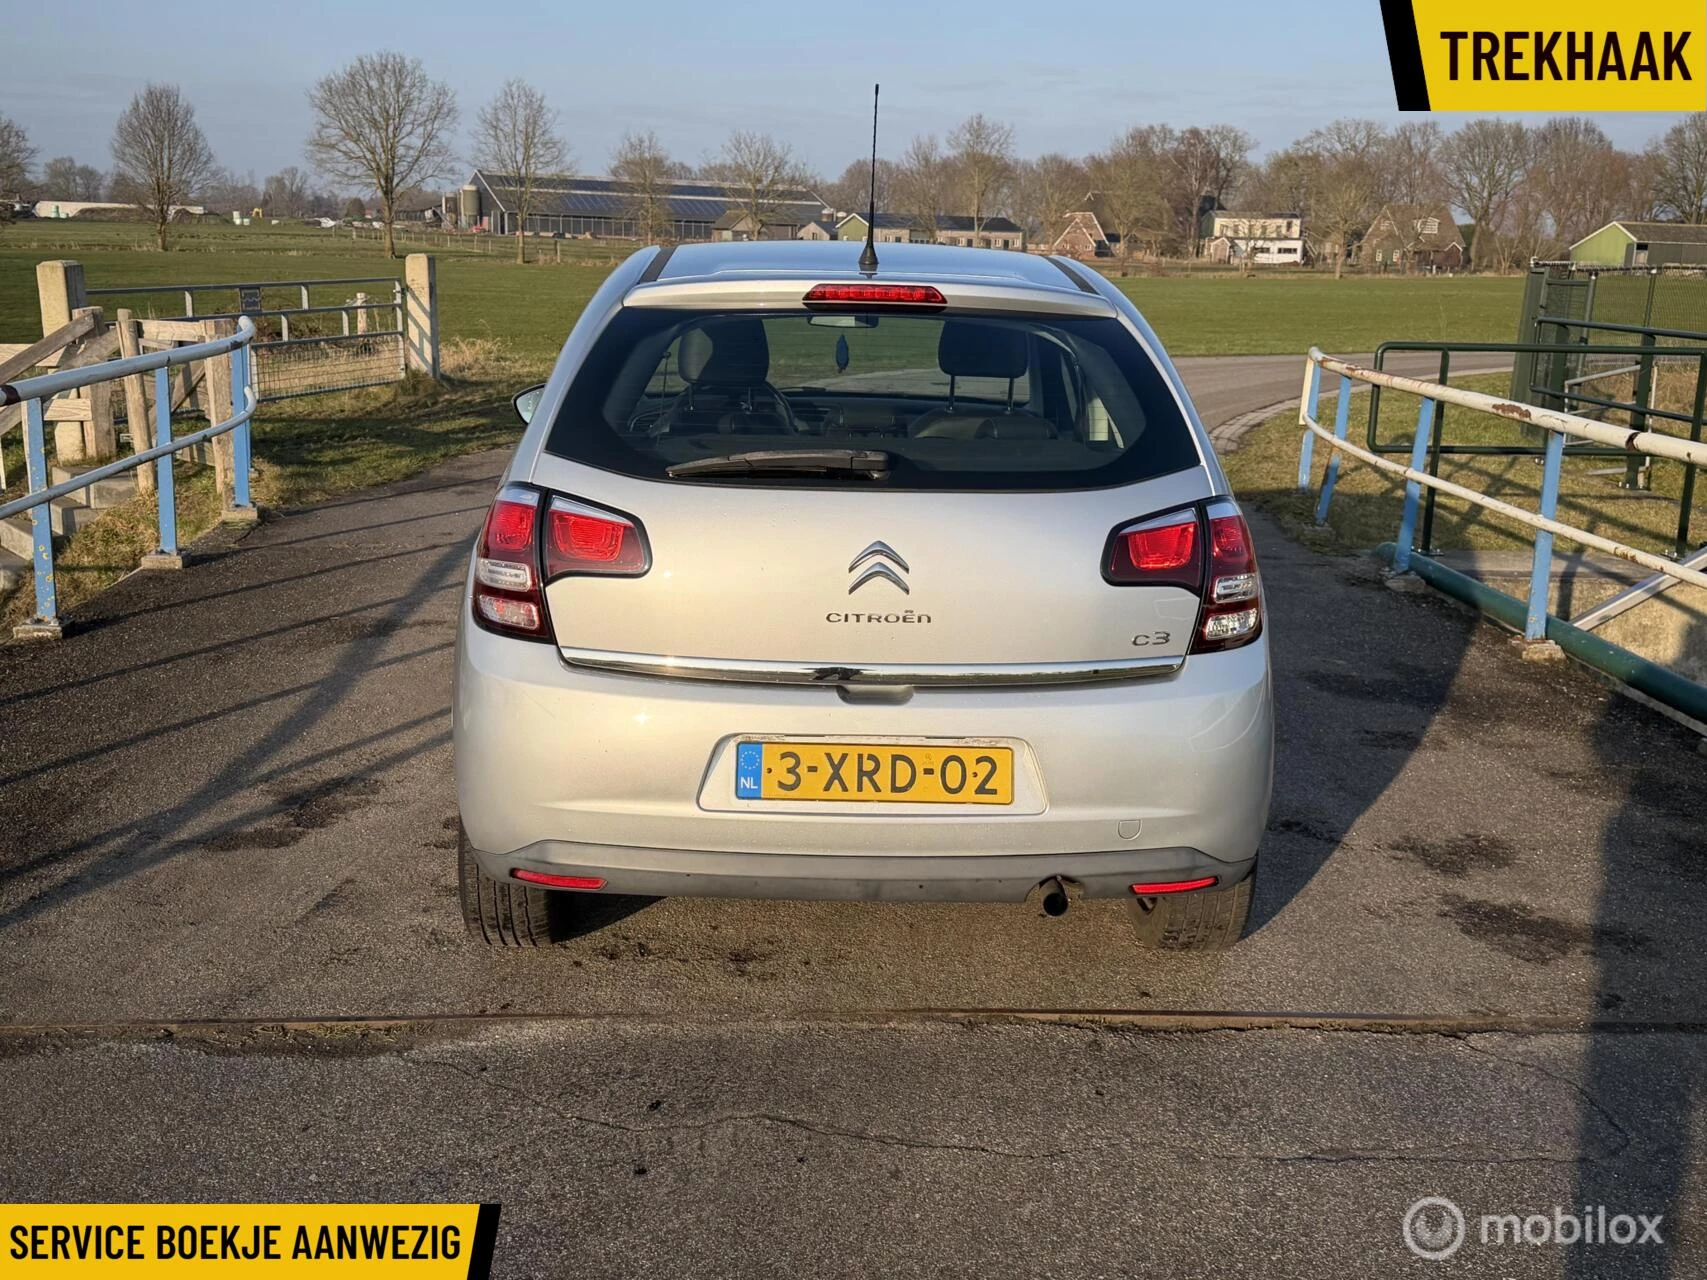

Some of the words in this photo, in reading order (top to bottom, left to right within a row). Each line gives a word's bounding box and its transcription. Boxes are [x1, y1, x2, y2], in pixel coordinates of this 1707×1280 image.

[1132, 631, 1170, 646] C3
[740, 776, 758, 789] NL
[777, 751, 998, 795] 3-XRD-02
